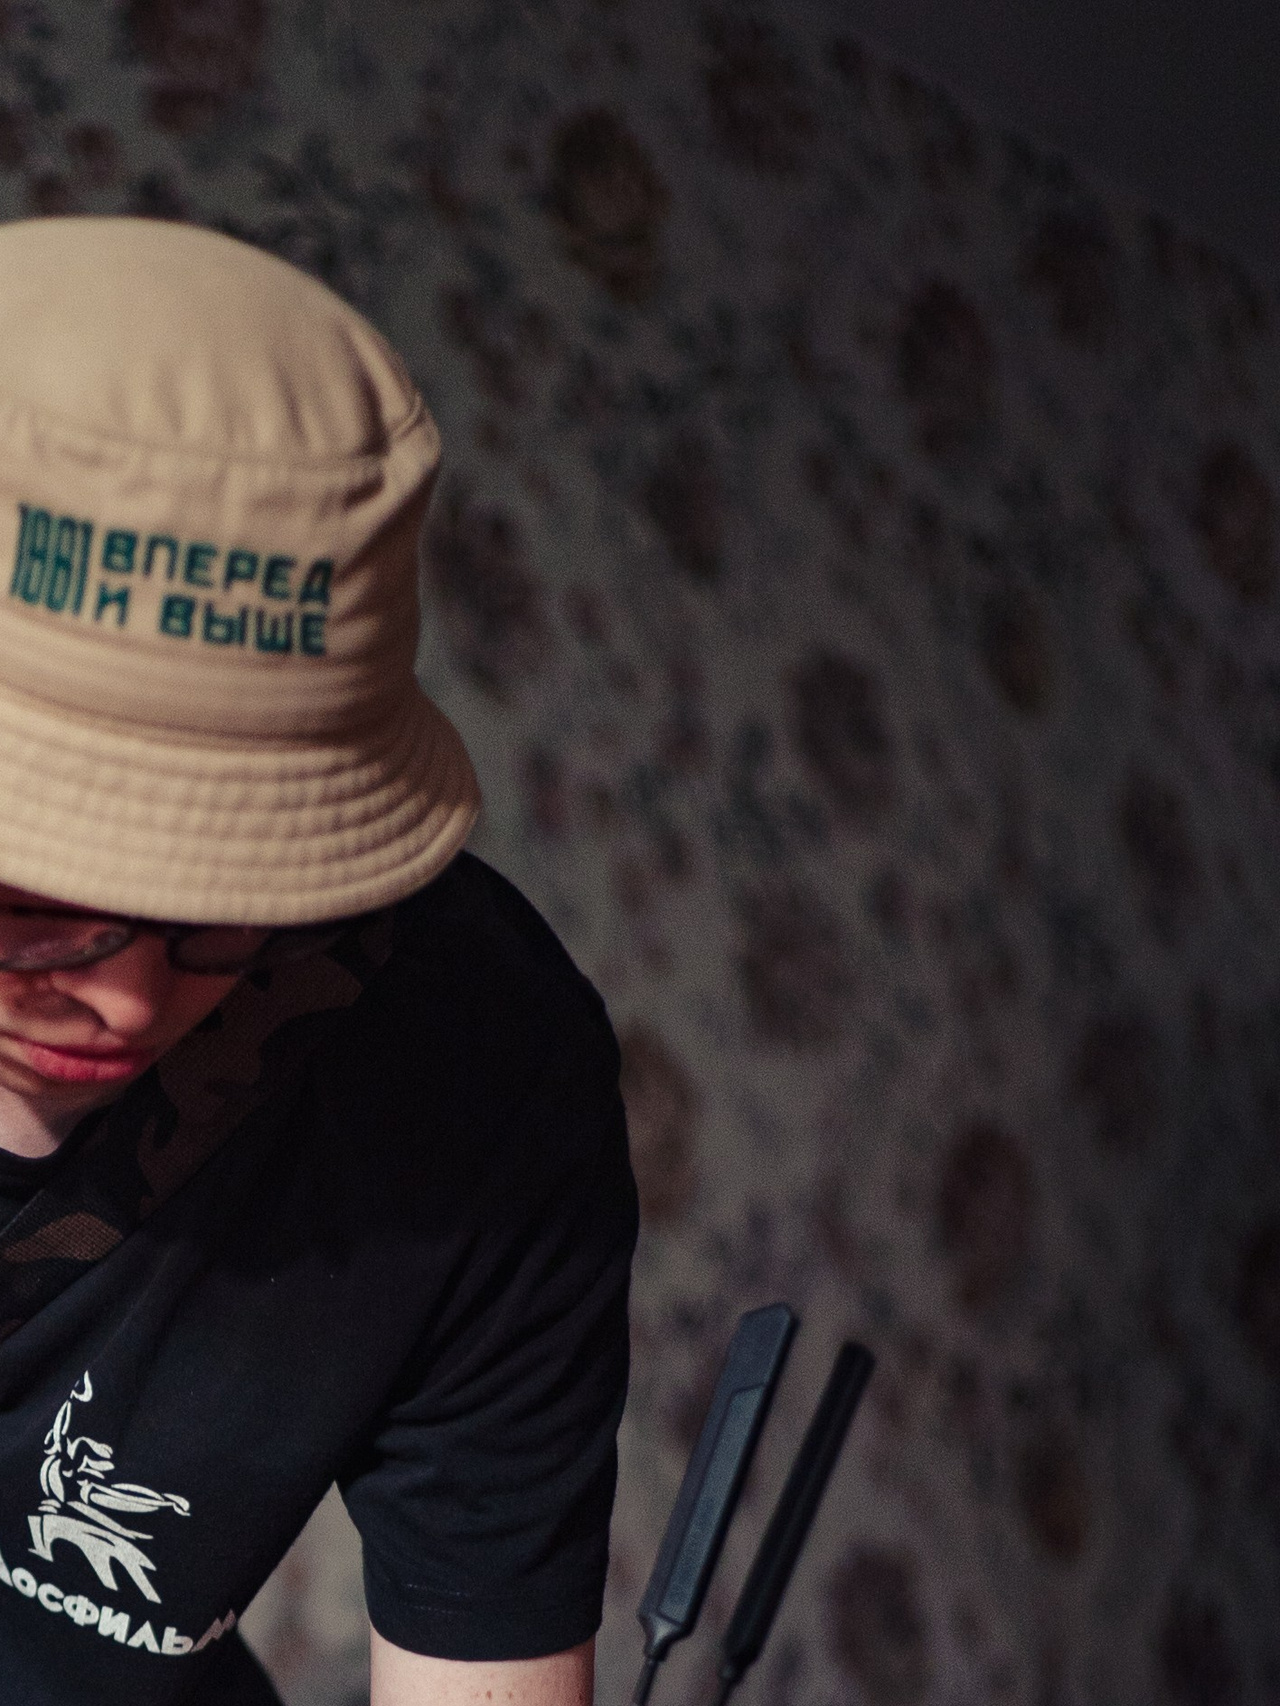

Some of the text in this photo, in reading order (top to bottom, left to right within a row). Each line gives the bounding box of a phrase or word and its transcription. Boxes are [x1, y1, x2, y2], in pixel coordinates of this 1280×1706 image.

[101, 528, 334, 607] ВПЕРЕД
[95, 581, 326, 657] И ВЫШЕ
